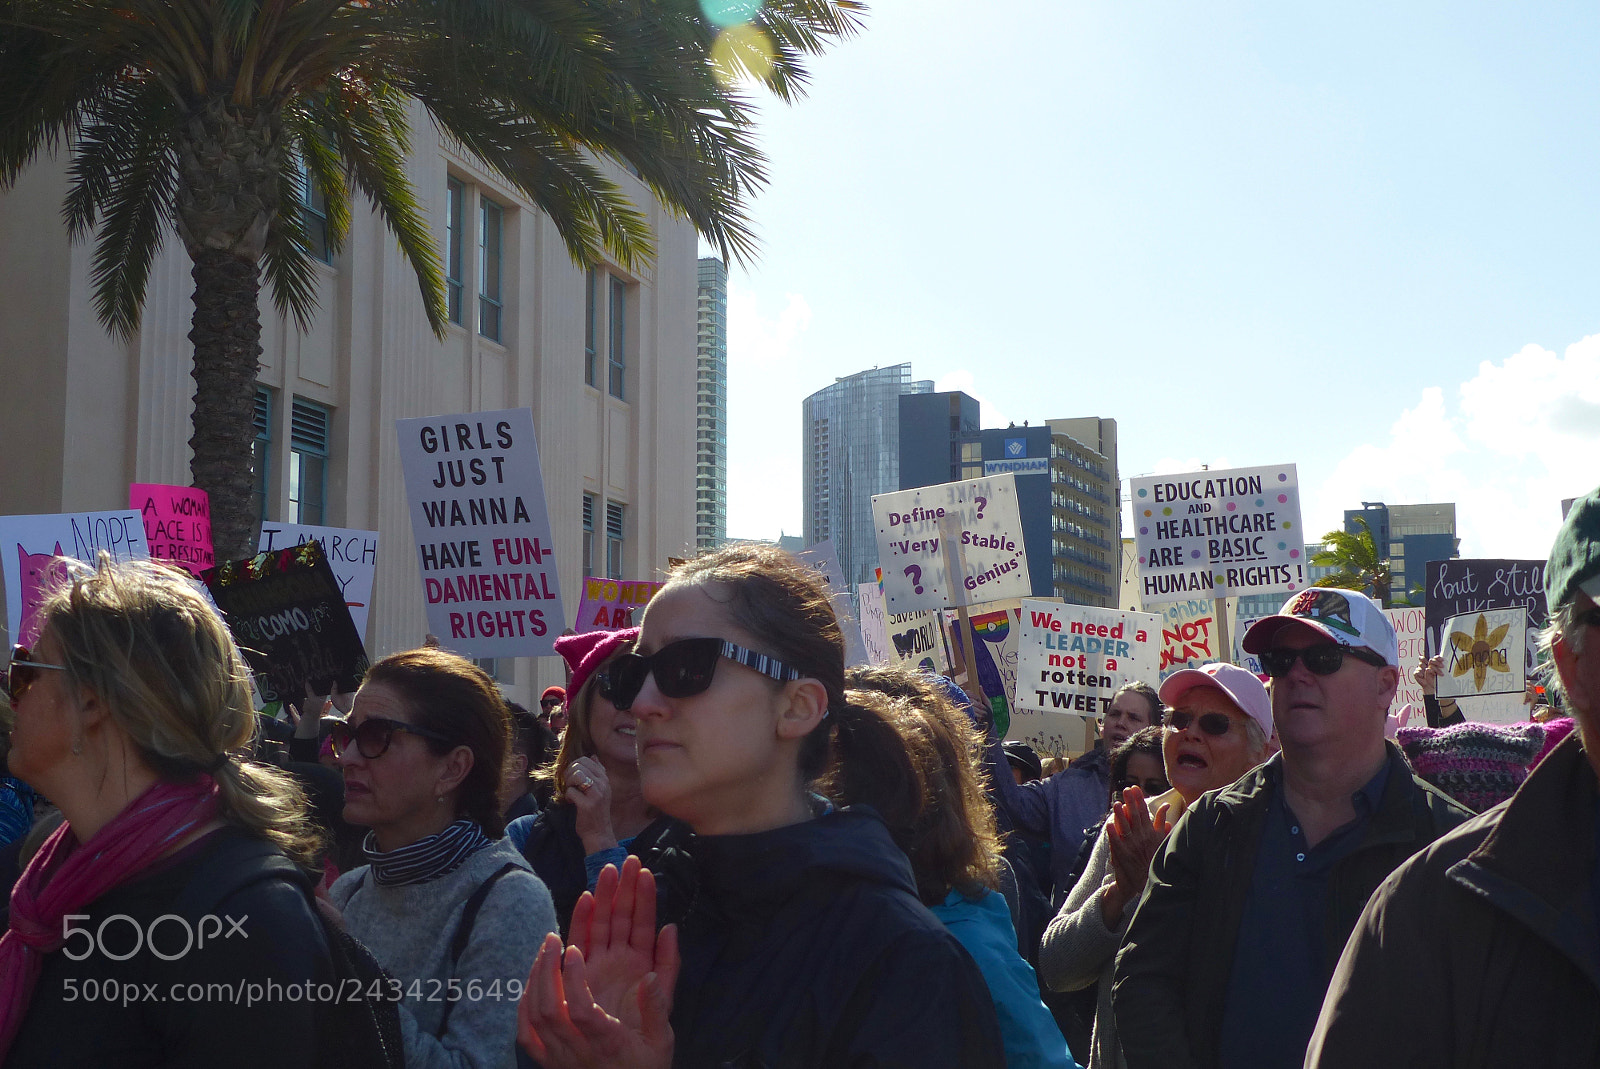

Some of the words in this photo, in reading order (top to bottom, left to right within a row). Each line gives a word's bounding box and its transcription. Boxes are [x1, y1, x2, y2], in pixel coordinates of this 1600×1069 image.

[420, 421, 513, 453] GIRLS
[432, 457, 504, 488] JUST
[986, 461, 1047, 473] WYNDHAM
[1154, 475, 1262, 503] EDUCATION
[143, 497, 158, 516] A
[422, 497, 531, 528] WANNA
[889, 507, 945, 526] Define
[1188, 503, 1211, 515] AND
[143, 520, 185, 541] LACE
[193, 522, 202, 542] IS
[1156, 512, 1277, 540] HEALTHCARE
[71, 516, 138, 568] NOPE
[420, 541, 482, 570] HAVE
[492, 537, 552, 566] FUN-
[961, 531, 1015, 551] Stable
[1148, 546, 1184, 568] ARE
[1208, 536, 1265, 560] BASIC
[425, 573, 556, 604] DAMENTAL
[1144, 570, 1214, 596] HUMAN
[1433, 564, 1479, 600] but
[259, 607, 309, 641] COMO
[449, 609, 547, 639] RIGHTS
[593, 606, 626, 628] AR
[1031, 611, 1061, 632] We
[1071, 621, 1123, 639] need
[1135, 630, 1147, 642] a
[1162, 617, 1212, 645] NOT
[892, 622, 934, 660] WORLD
[1045, 633, 1130, 658] LEADER
[1048, 653, 1087, 669] not
[1105, 658, 1118, 672] a
[1041, 670, 1112, 688] rotten
[1035, 690, 1112, 714] TWEET
